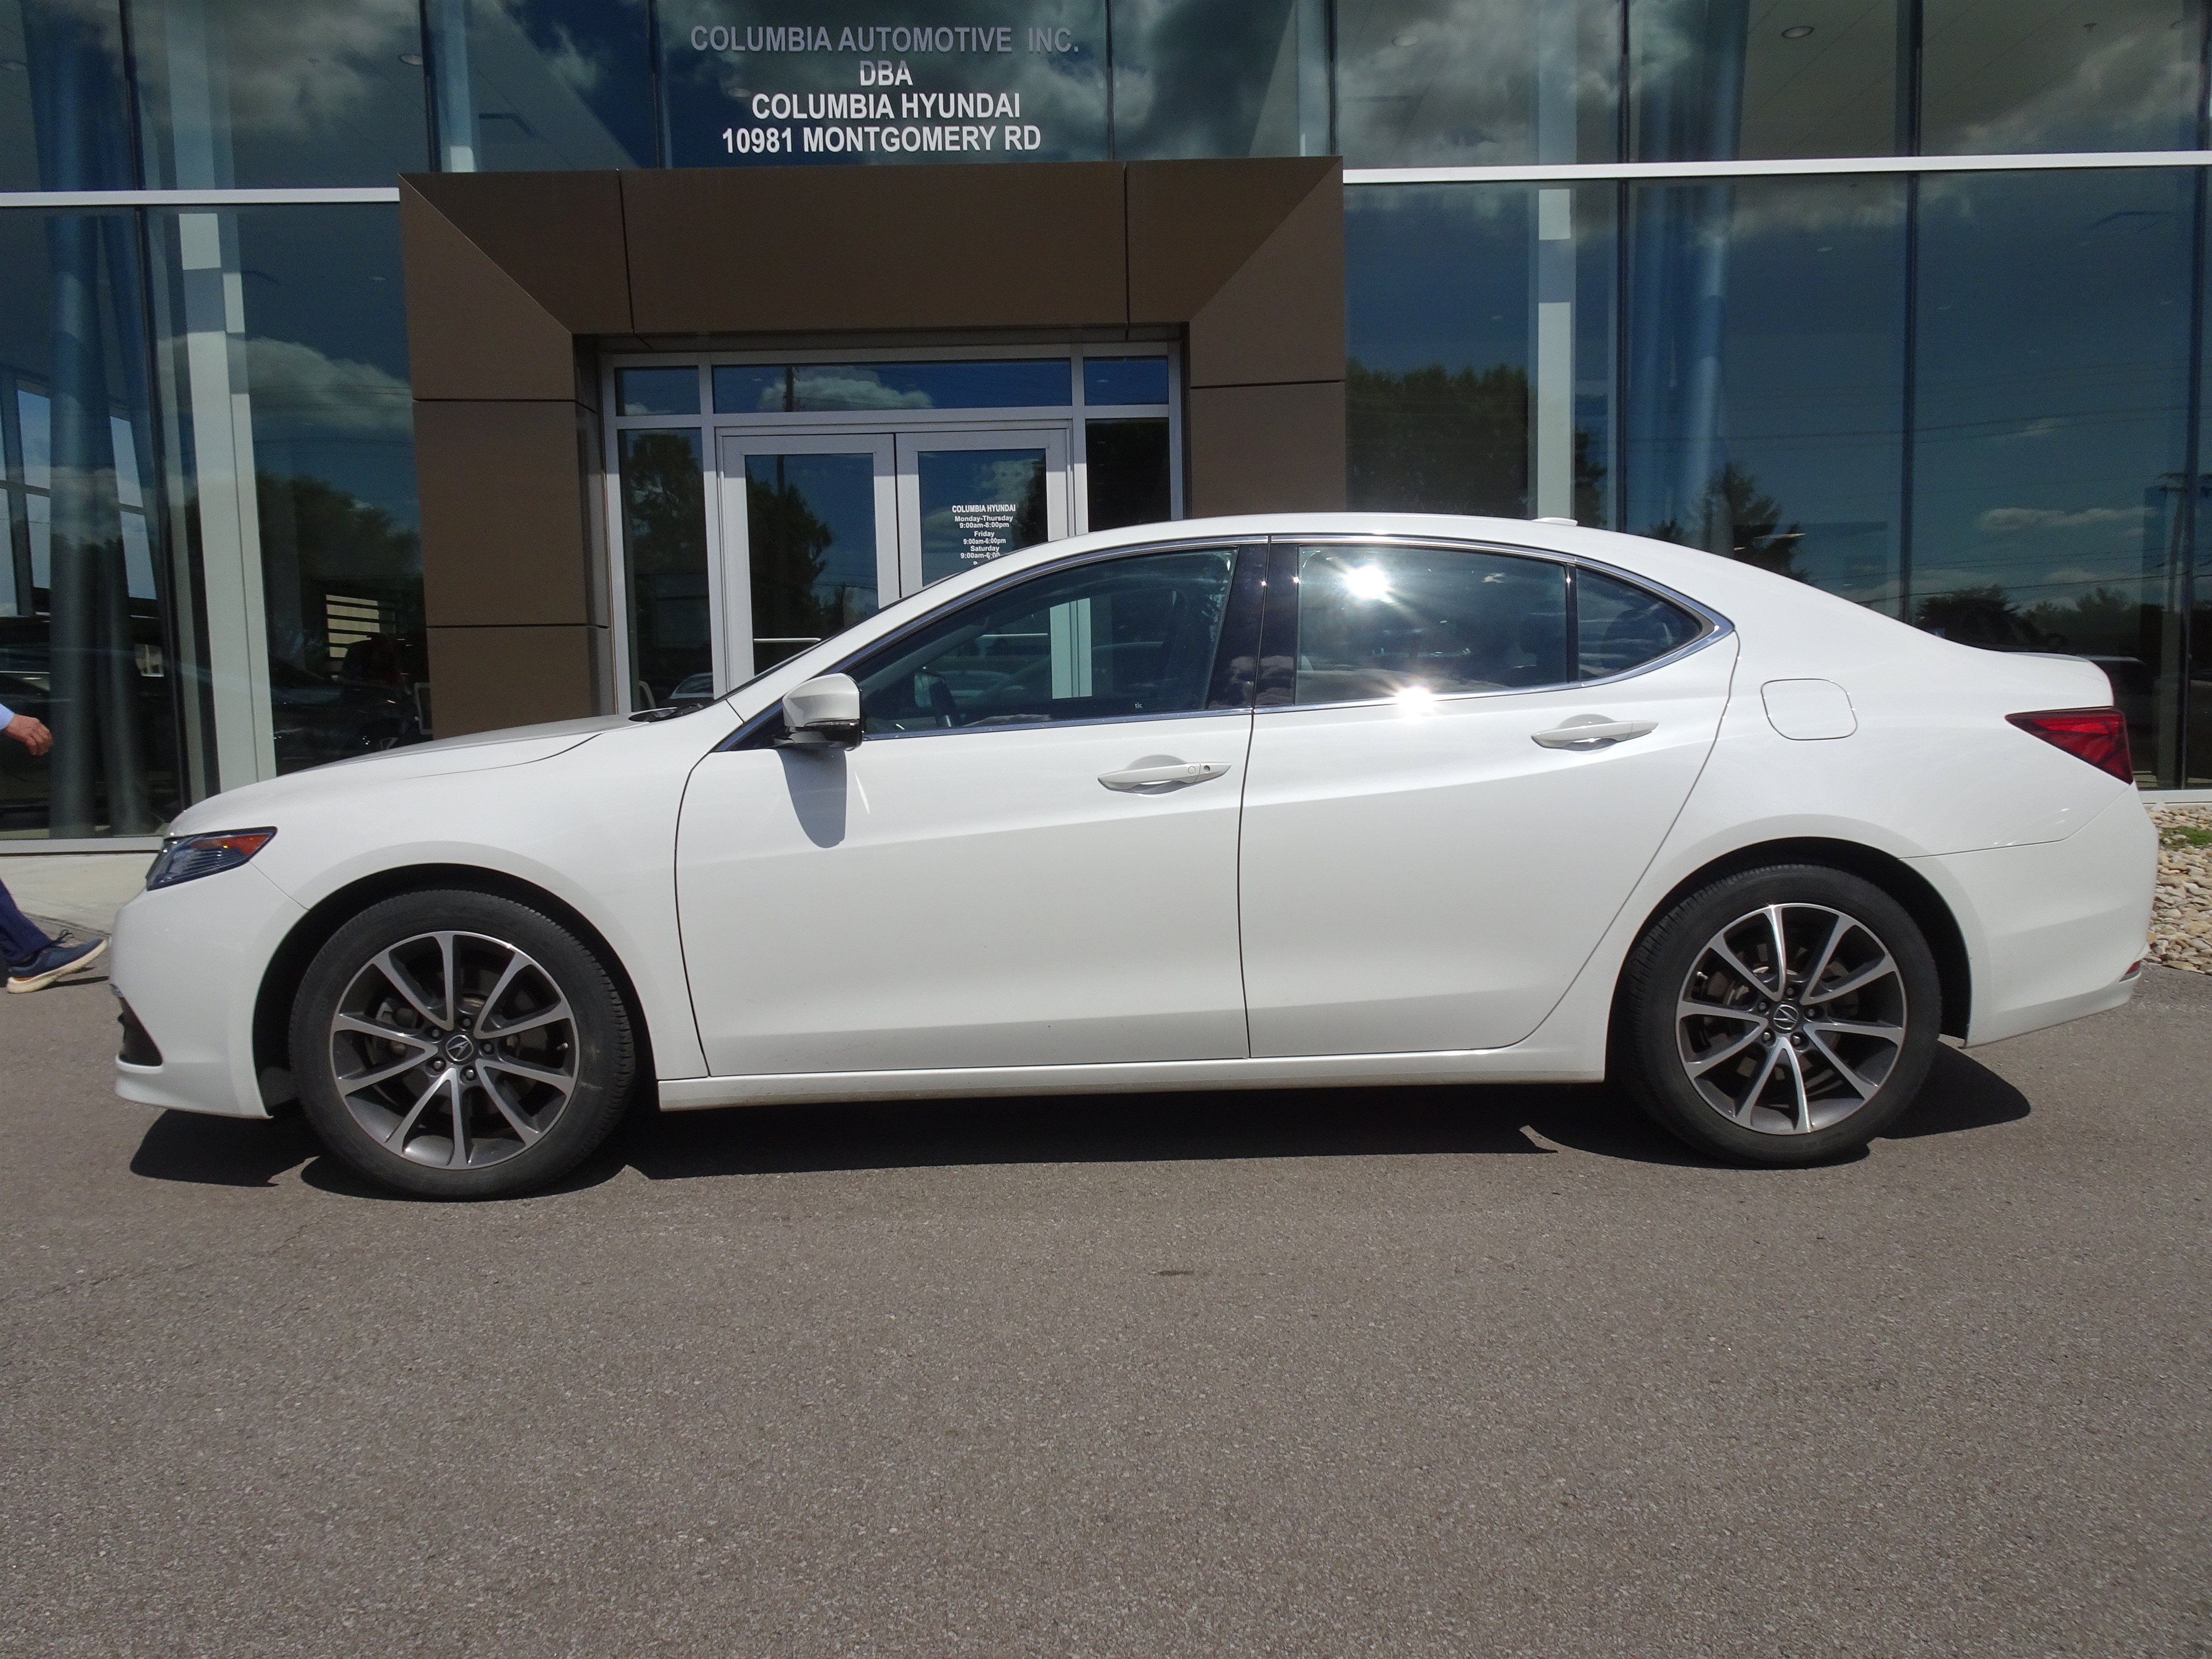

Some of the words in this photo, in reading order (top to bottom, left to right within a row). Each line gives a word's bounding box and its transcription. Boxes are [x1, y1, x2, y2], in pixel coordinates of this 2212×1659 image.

[691, 26, 833, 52] COLUMBIA
[838, 26, 1012, 52] AUTOMOTIVE
[1028, 28, 1079, 53] INC.
[860, 60, 913, 86] DBA
[752, 94, 894, 119] COLUMBIA
[902, 92, 1020, 118] HYUNDAI
[723, 128, 792, 153] 10981
[804, 126, 996, 152] MONTGOMERY
[1004, 125, 1041, 150] RD
